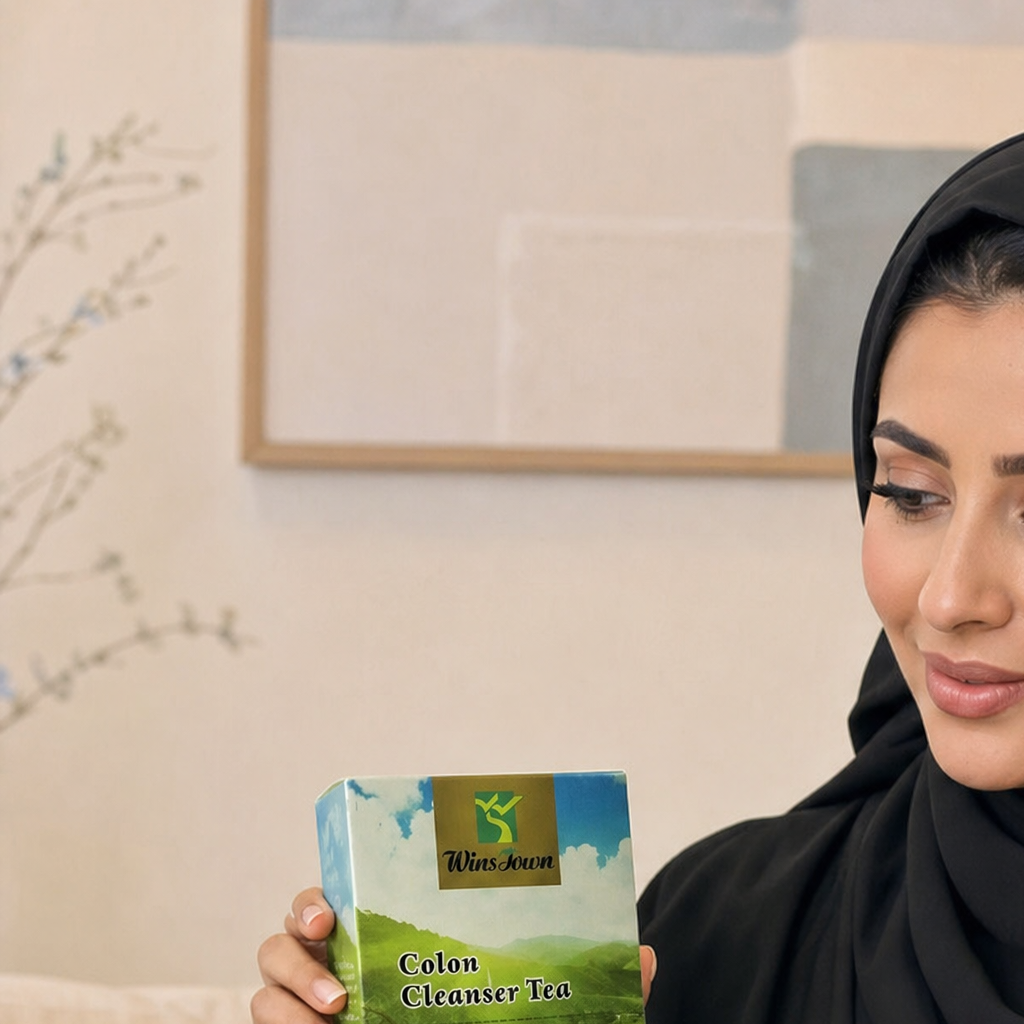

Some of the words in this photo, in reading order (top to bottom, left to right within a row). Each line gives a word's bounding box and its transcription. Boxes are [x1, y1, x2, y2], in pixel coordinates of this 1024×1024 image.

[398, 951, 480, 976] Colon
[400, 983, 519, 1009] Cleanser
[525, 977, 572, 1002] Tea
